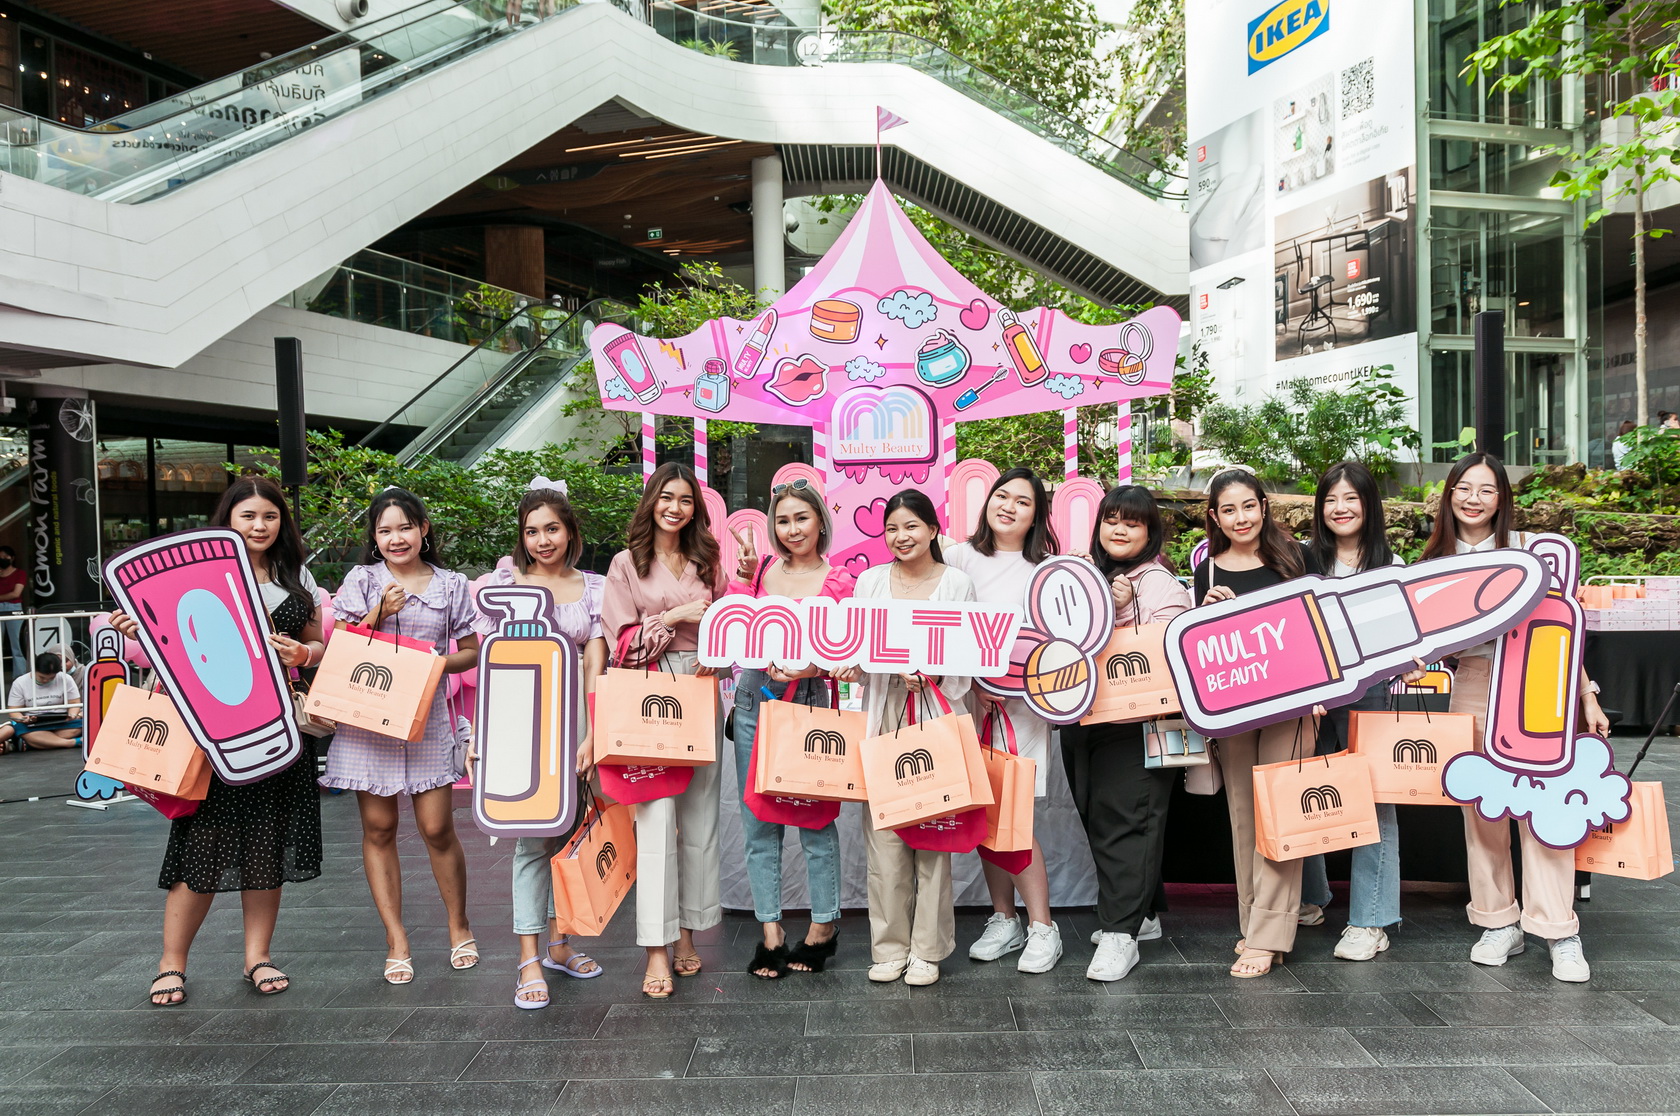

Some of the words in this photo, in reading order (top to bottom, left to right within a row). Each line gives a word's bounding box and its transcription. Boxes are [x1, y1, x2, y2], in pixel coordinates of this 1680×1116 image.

[1256, 0, 1322, 54] IKEA
[803, 43, 818, 56] L2
[1198, 178, 1211, 192] 590
[1347, 291, 1373, 310] 1,690
[738, 350, 752, 370] MULTY
[840, 443, 877, 458] Multy
[881, 442, 923, 457] Beauty
[30, 439, 50, 505] Farm
[49, 471, 58, 492] foods
[50, 494, 60, 520] natural
[52, 521, 61, 535] and
[33, 512, 56, 597] Lemon
[53, 537, 63, 565] organic
[708, 603, 1015, 668] MULTY
[1196, 617, 1286, 669] MULTY
[1108, 679, 1128, 687] Multy
[1130, 675, 1152, 683] Beauty
[1206, 659, 1269, 693] BEAUTY
[347, 683, 365, 694] Multy
[366, 688, 387, 700] Beauty
[641, 718, 660, 727] Multy
[662, 719, 682, 728] Beauty
[126, 738, 143, 751] Multy
[143, 744, 162, 756] Beauty
[804, 753, 822, 762] Multy
[824, 755, 845, 765] Beauty
[1393, 763, 1413, 772] Multy
[1415, 764, 1438, 773] Beauty
[897, 779, 914, 788] Multy
[916, 772, 936, 783] Beauty
[1303, 813, 1322, 822] Multy
[1323, 809, 1344, 818] Beauty
[1591, 832, 1613, 843] Beauty
